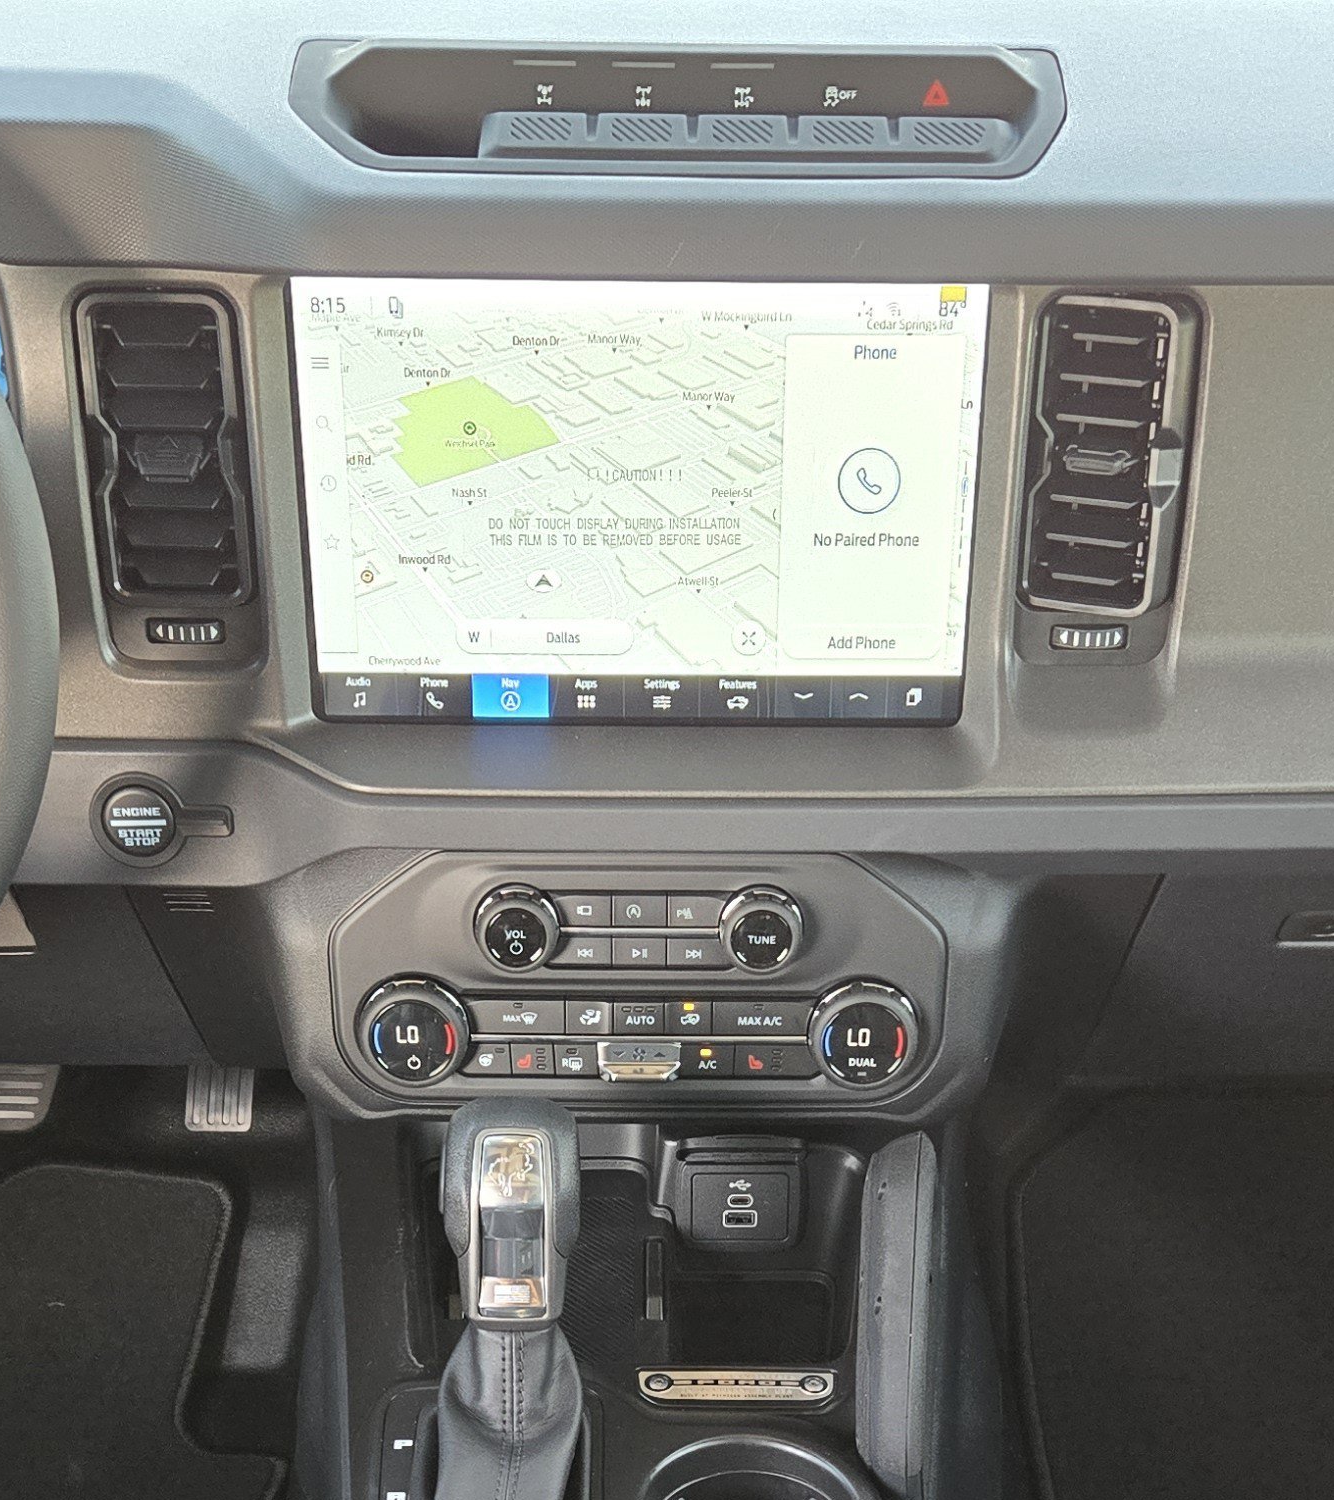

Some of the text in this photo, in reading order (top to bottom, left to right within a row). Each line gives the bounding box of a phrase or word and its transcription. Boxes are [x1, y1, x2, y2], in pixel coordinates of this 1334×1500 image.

[839, 90, 858, 100] OFF
[310, 296, 346, 314] 8:15
[715, 311, 777, 324] Mockingbird
[866, 319, 954, 332] Cedar Springs Rd
[512, 335, 561, 346] Denton Dr
[587, 334, 640, 346] Manor Way
[854, 345, 898, 360] Phone
[404, 367, 451, 378] Denton Dr
[682, 391, 736, 403] Manor Way
[451, 487, 488, 498] Nash St
[711, 487, 741, 498] Peeler
[488, 517, 740, 530] DO NOT TOUCH DISPLAY DURING INSTALLATION
[490, 534, 742, 546] THIS FILM IS TO BE REMOVED BEFORE USAGE
[814, 533, 920, 547] No Paired Phone
[398, 554, 451, 565] Inwood Rd
[677, 576, 707, 586] Atwell
[468, 631, 480, 643] W
[546, 631, 580, 644] Dallas
[827, 637, 897, 650] Add Phone
[368, 656, 440, 667] Cherrywood Ave
[346, 676, 371, 687] Audio
[420, 676, 449, 688] Phone
[501, 678, 520, 688] Nav
[574, 678, 598, 690] Apps
[643, 679, 681, 691] Settings
[719, 679, 757, 690] Features
[112, 807, 161, 818] ENGINE
[117, 828, 163, 838] START
[124, 837, 161, 847] STOP
[504, 930, 526, 940] VOL
[747, 934, 777, 945] TUNE
[503, 1015, 521, 1023] MAX
[625, 1016, 655, 1026] AUTO
[737, 1016, 782, 1026] MAX A/C
[395, 1025, 419, 1044] LO
[846, 1028, 870, 1047] LO
[698, 1060, 717, 1070] A/C
[848, 1058, 877, 1068] DUAL
[393, 1439, 413, 1450] P
